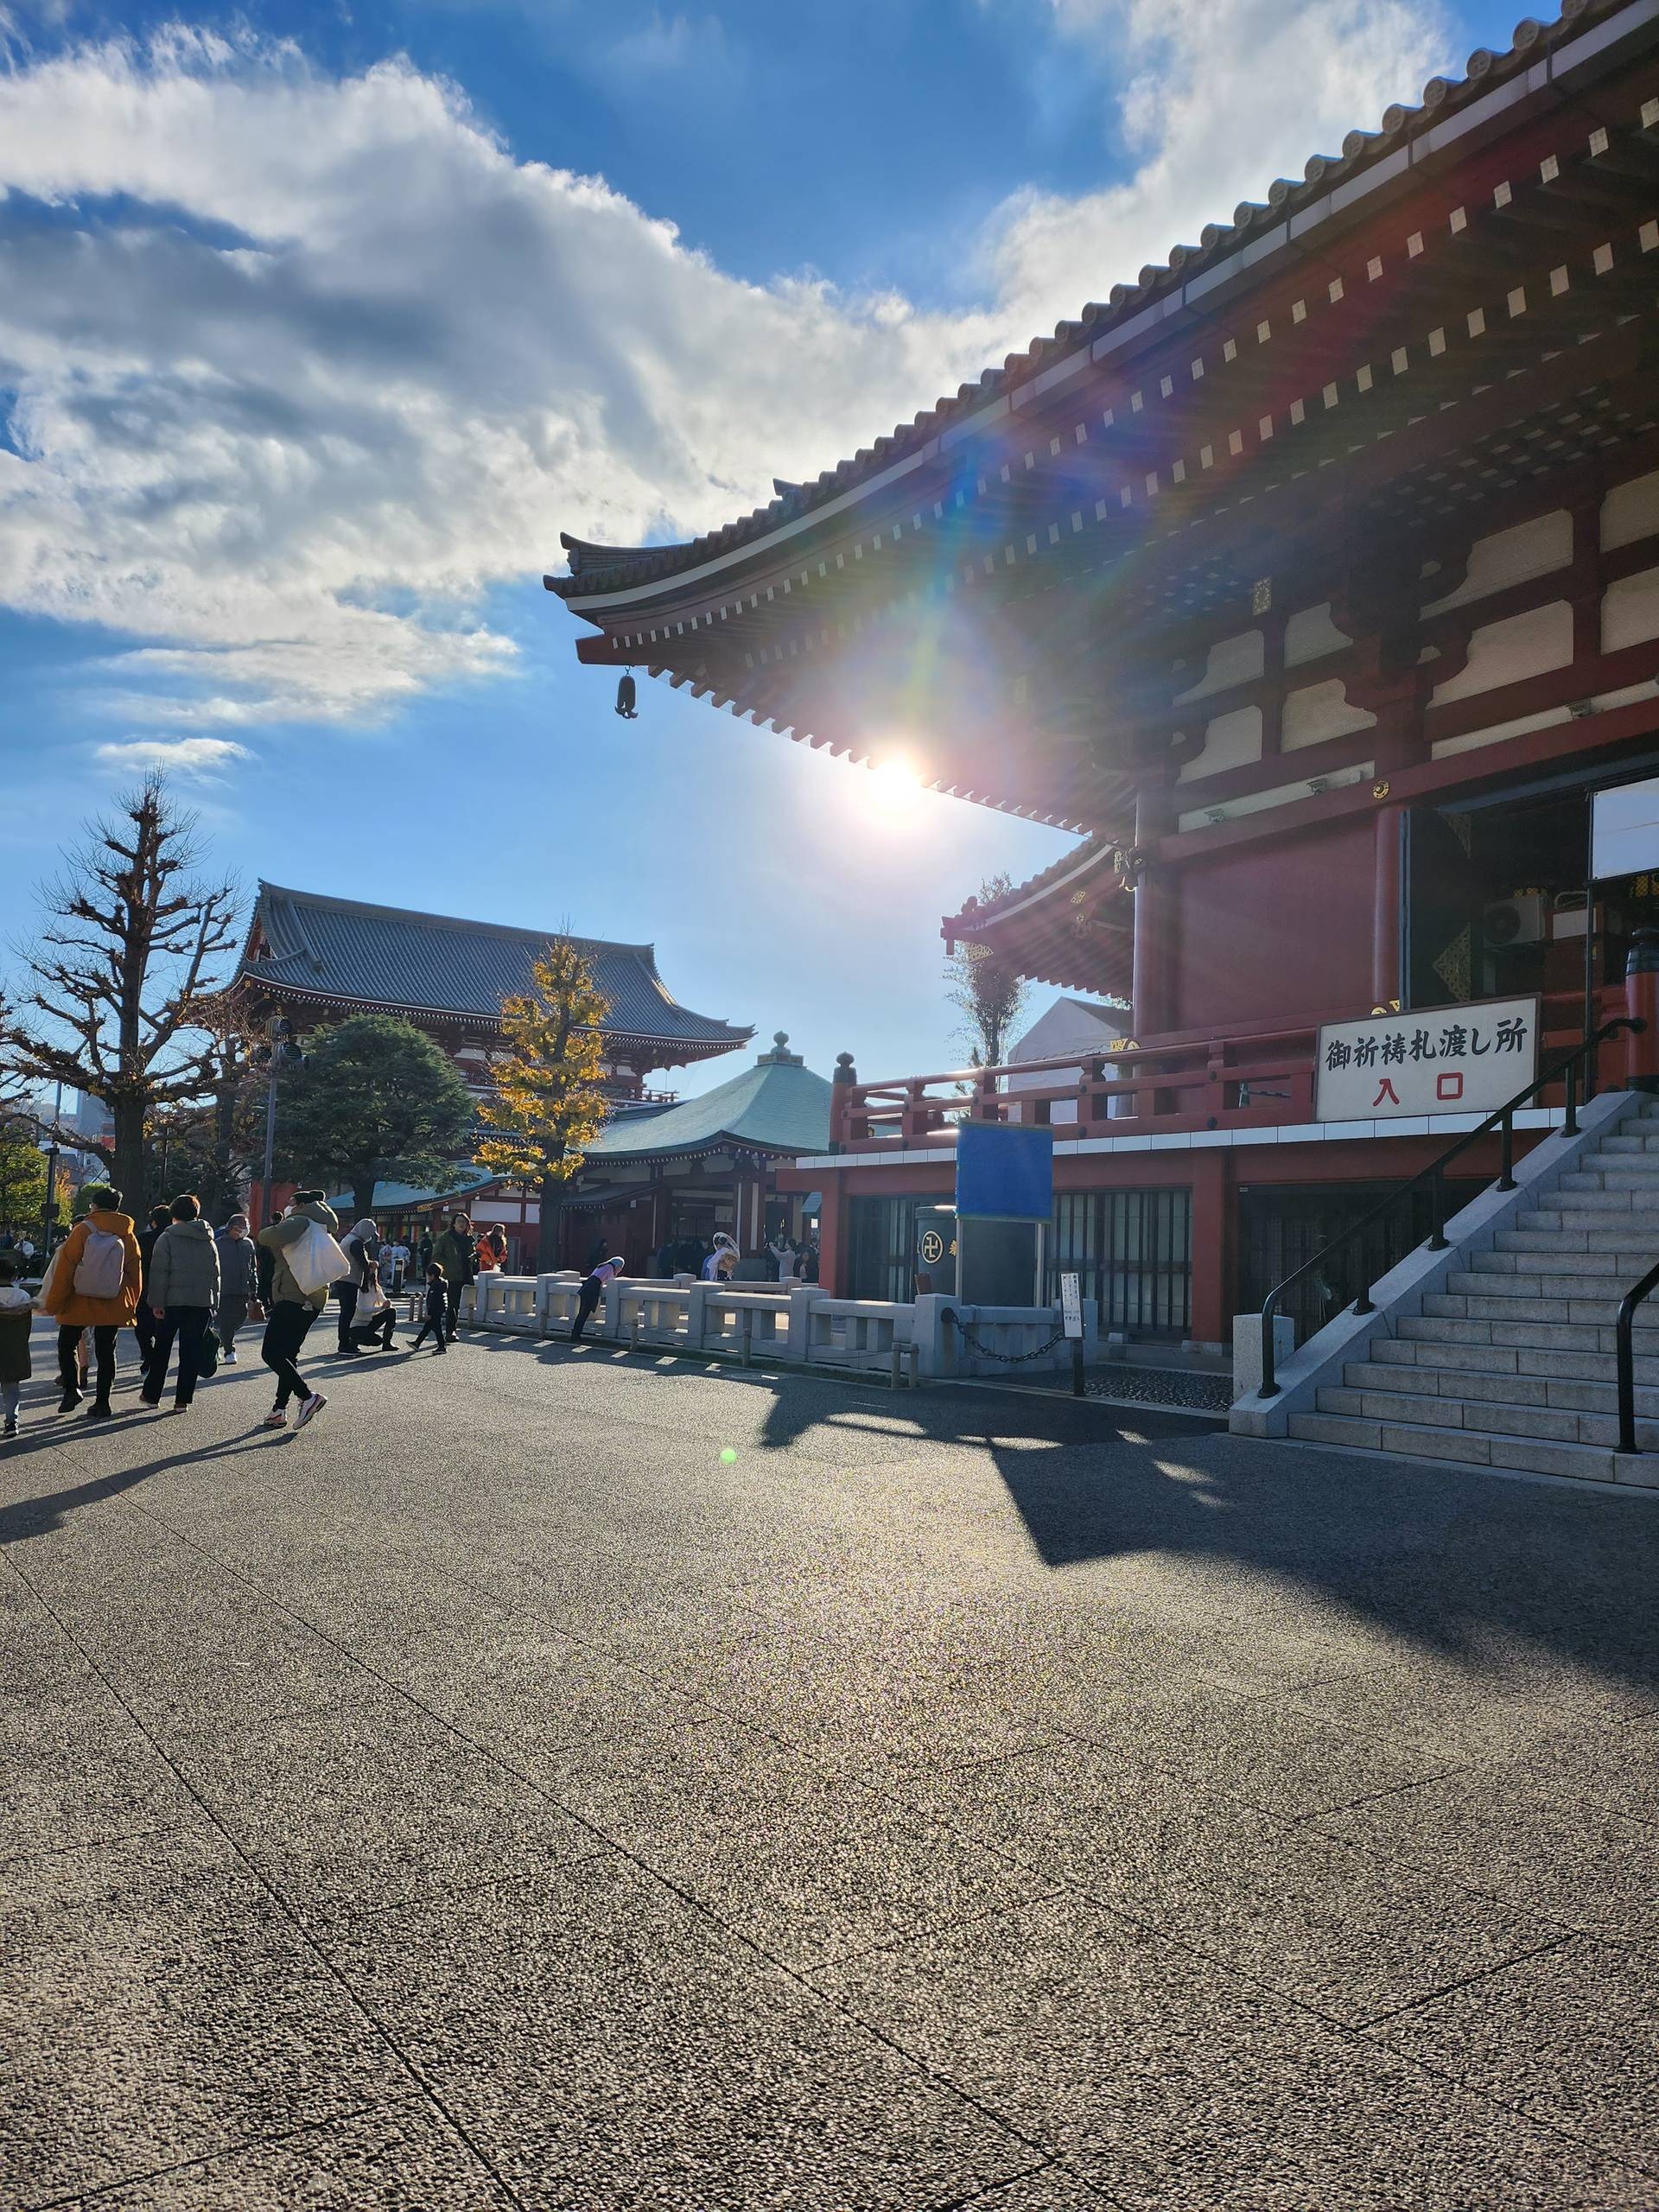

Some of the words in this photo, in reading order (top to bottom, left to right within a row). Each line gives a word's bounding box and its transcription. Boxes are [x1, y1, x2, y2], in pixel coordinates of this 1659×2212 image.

[1325, 1017, 1528, 1071] 御祈祷札渡し所
